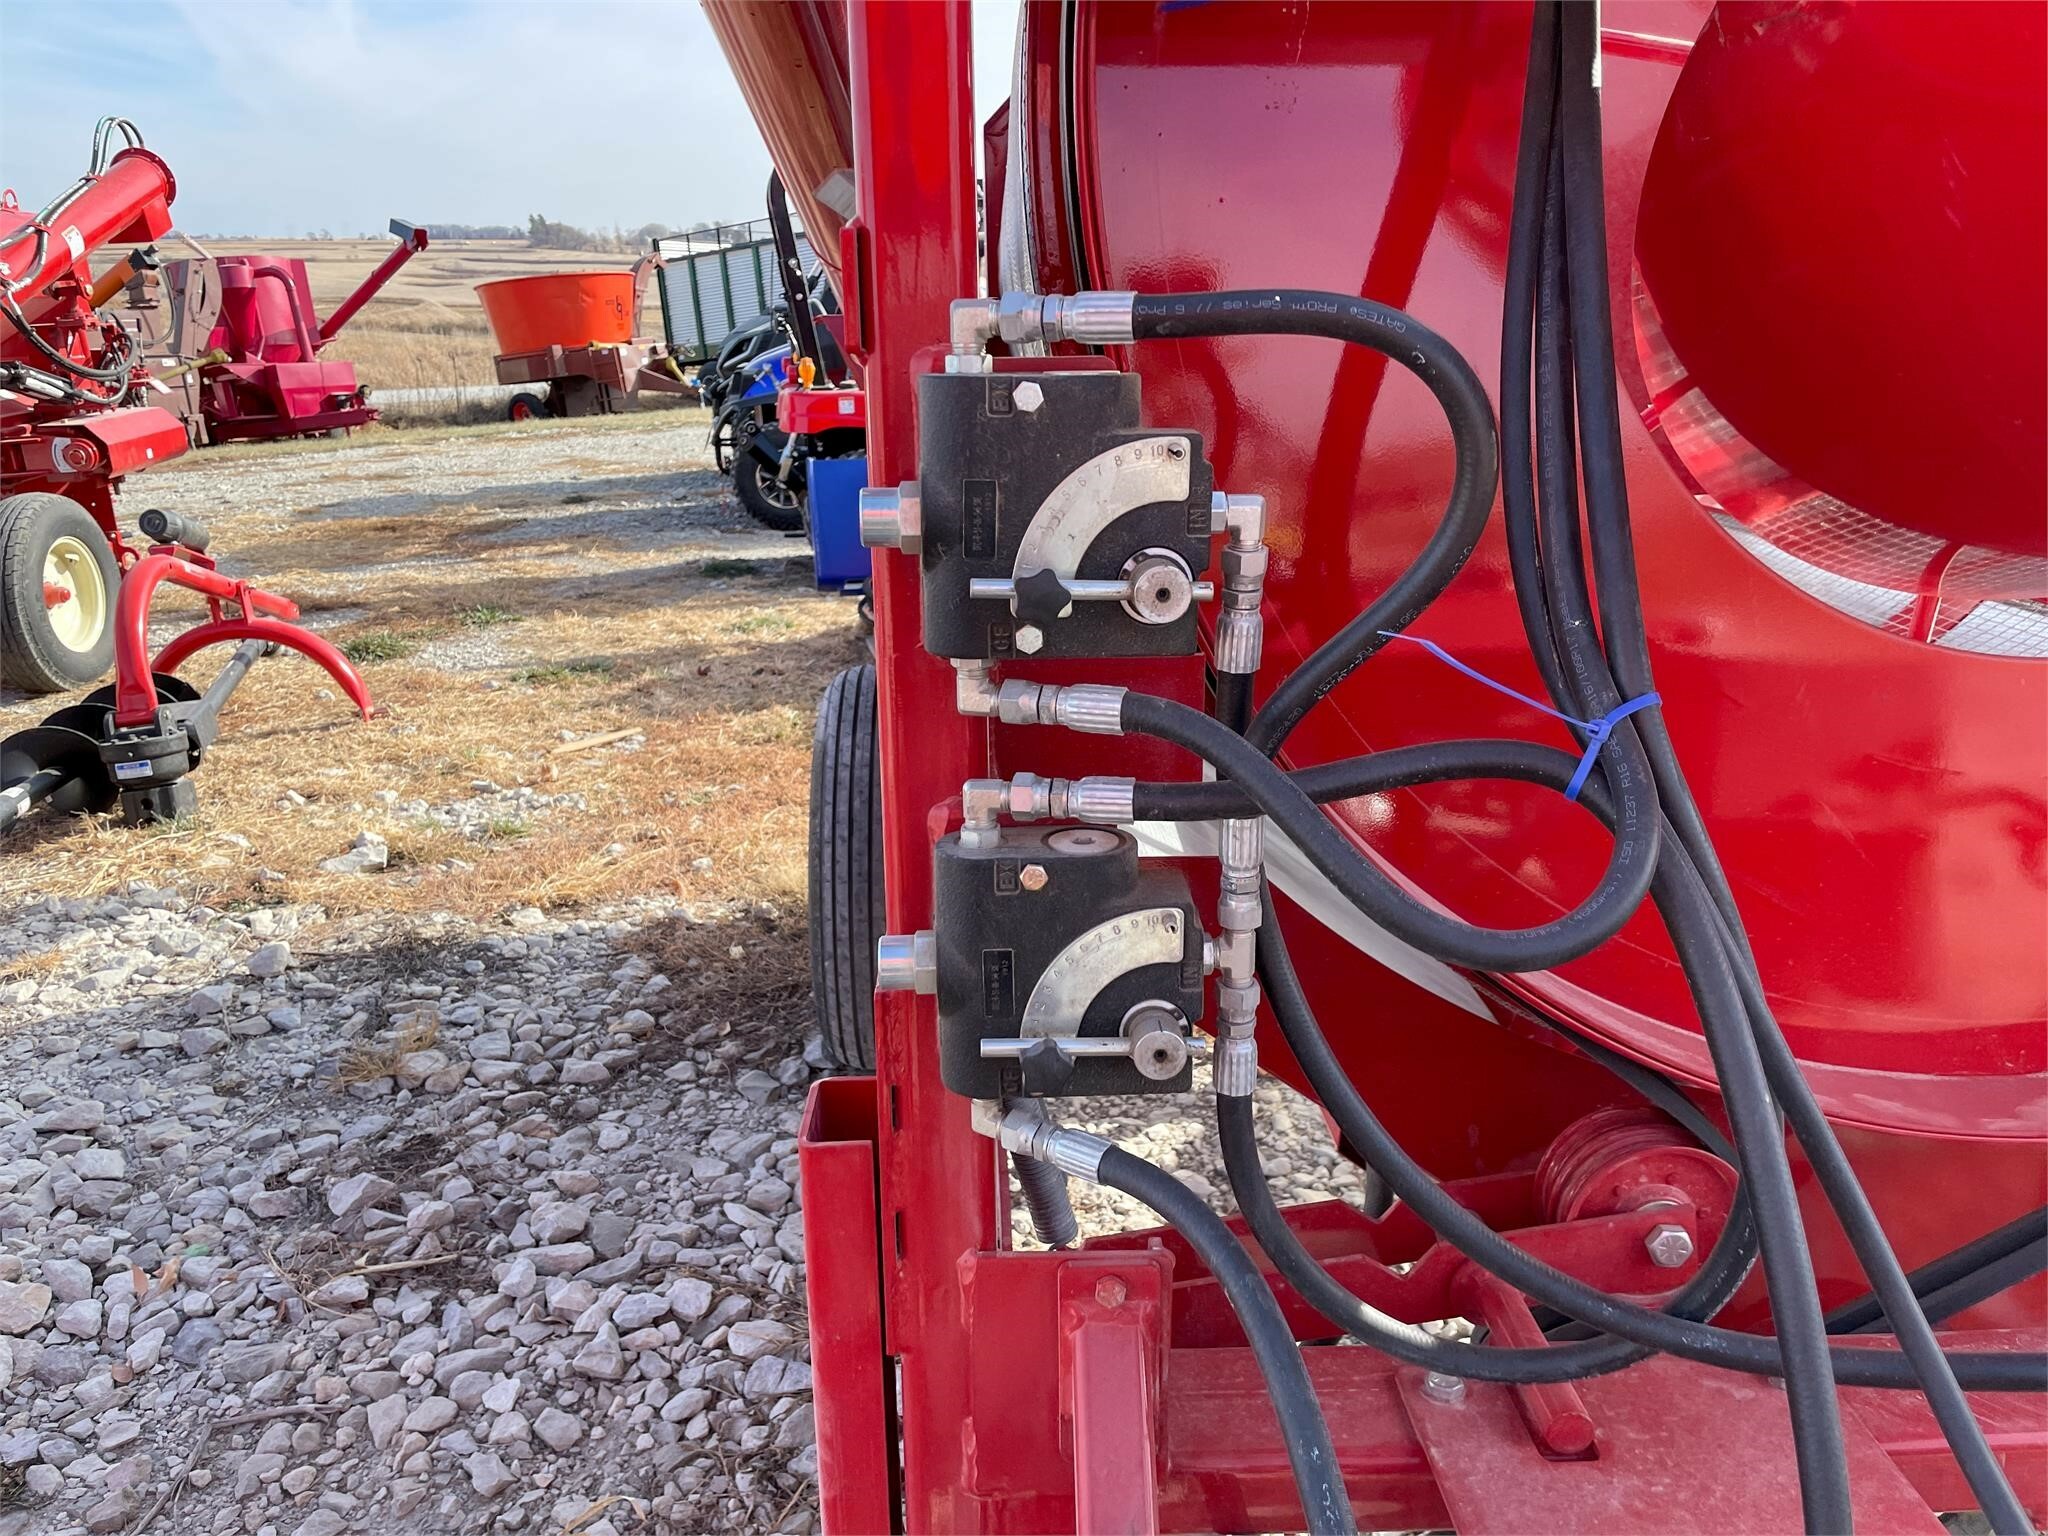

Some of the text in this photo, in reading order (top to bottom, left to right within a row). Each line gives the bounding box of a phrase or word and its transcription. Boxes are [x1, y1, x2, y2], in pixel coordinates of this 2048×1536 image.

[991, 382, 1009, 412] EX
[1061, 489, 1072, 501] 5
[1077, 476, 1087, 488] 6
[1094, 463, 1103, 476] 7
[1114, 455, 1122, 466] 8
[1134, 448, 1142, 460] 9
[1150, 444, 1164, 457] 10
[1189, 509, 1208, 528] IN
[1608, 731, 1623, 758] SAE
[1624, 795, 1637, 832] 11237
[1618, 840, 1634, 865] ISO
[999, 864, 1016, 889] EX
[1064, 955, 1075, 966] 5
[1079, 943, 1089, 953] 6
[1095, 933, 1105, 944] 7
[1112, 924, 1121, 936] 8
[1130, 919, 1139, 930] 9
[1146, 914, 1159, 927] 10
